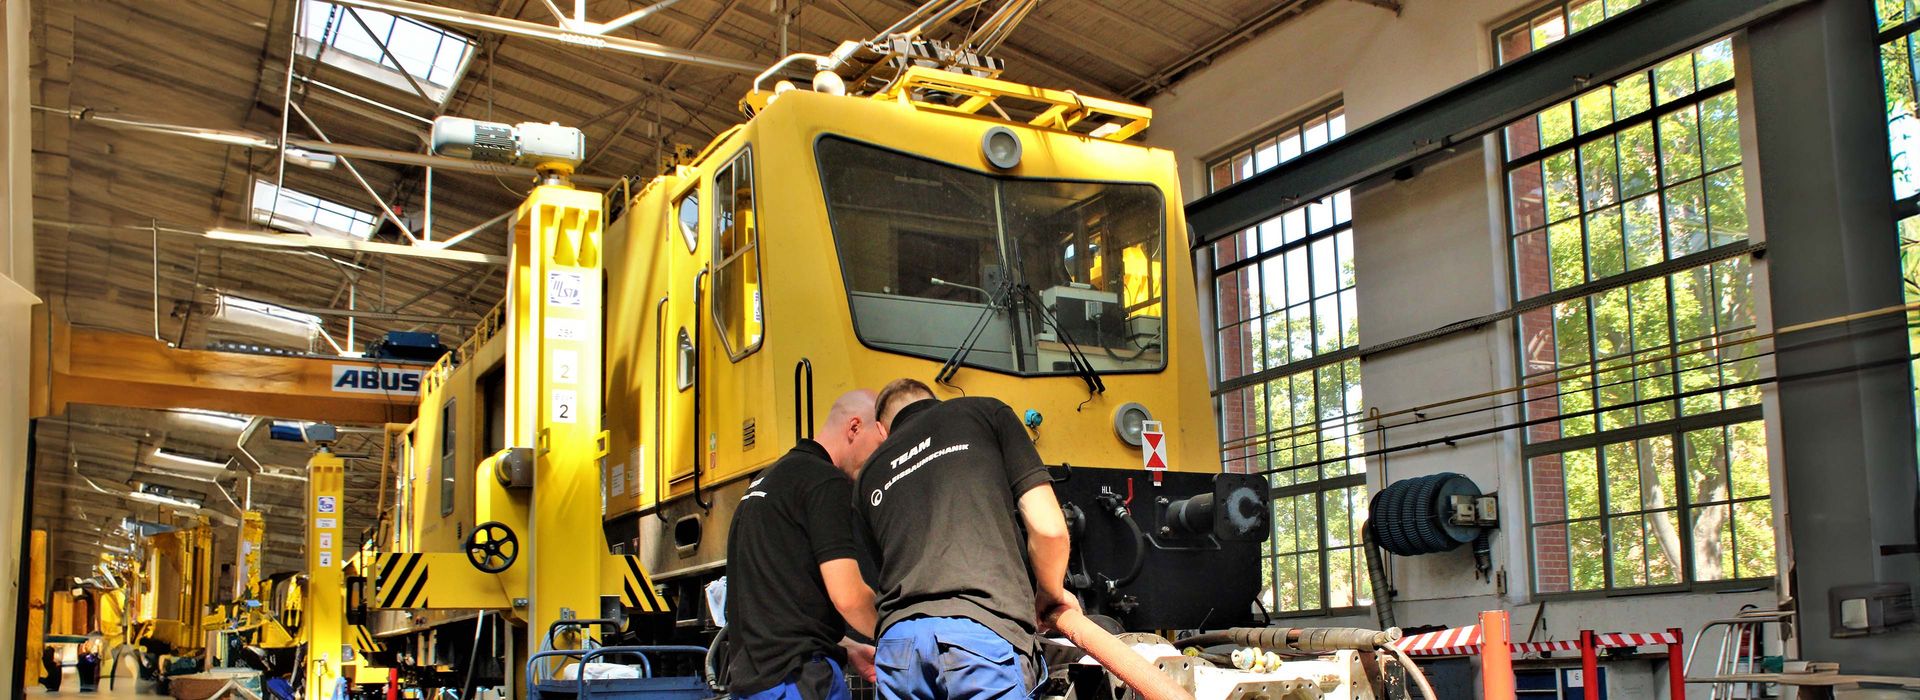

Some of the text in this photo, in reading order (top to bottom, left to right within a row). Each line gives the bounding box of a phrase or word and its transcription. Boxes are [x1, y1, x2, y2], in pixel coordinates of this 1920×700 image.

[560, 364, 569, 379] 2
[334, 369, 420, 392] ABUS
[559, 403, 569, 419] 2
[890, 436, 932, 470] TEAM
[322, 557, 329, 566] 4
